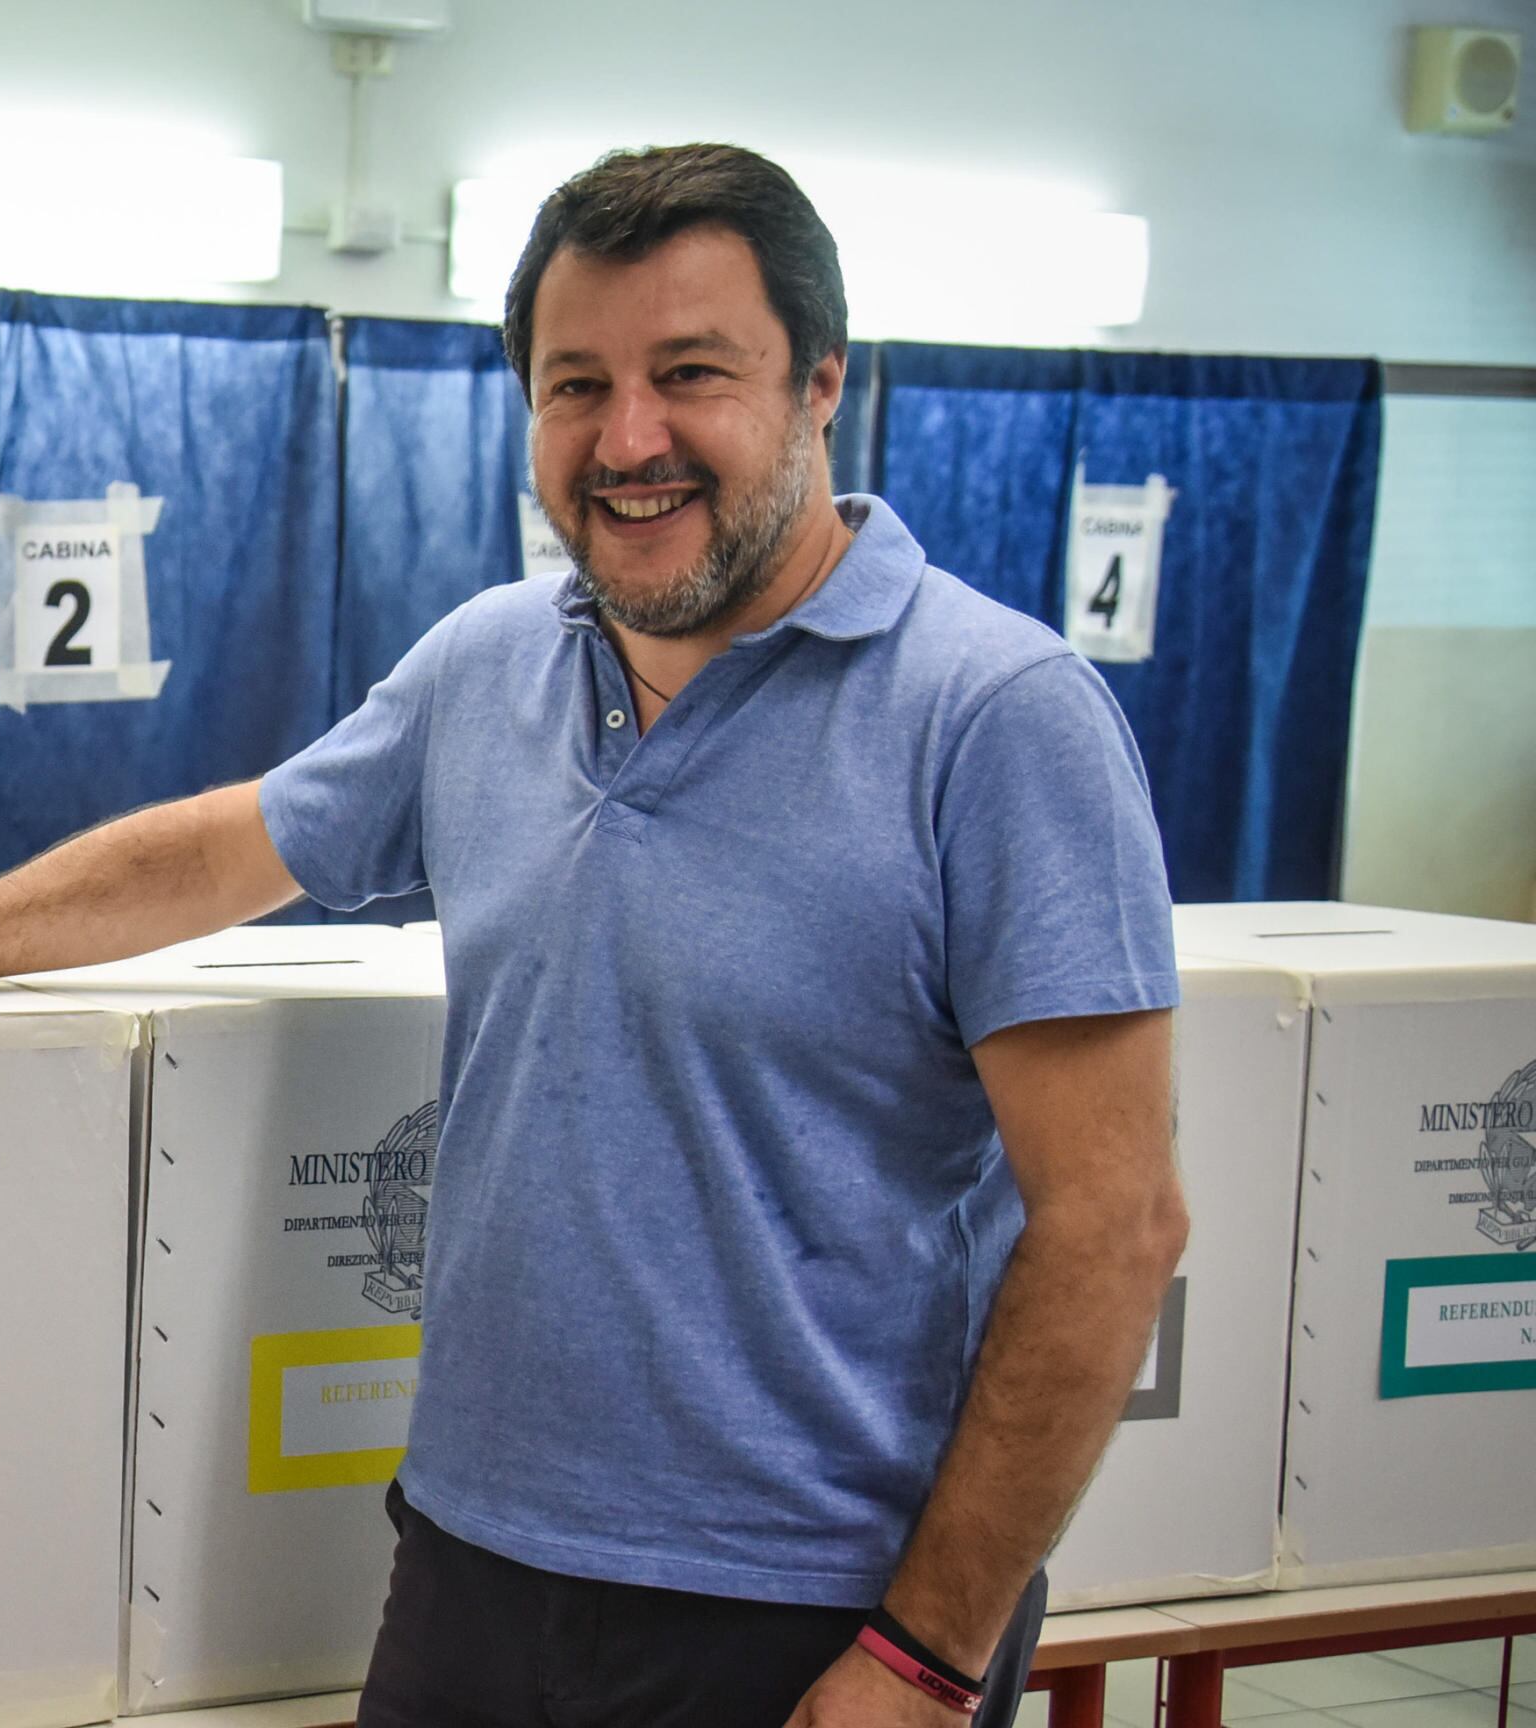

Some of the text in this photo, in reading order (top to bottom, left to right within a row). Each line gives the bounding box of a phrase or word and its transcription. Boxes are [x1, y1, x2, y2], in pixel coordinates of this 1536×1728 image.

[22, 540, 112, 561] CABINA
[1089, 553, 1121, 629] 4
[44, 578, 92, 666] 2
[1419, 1101, 1534, 1132] MINISTERO
[288, 1150, 426, 1186] MINISTERO
[1414, 1159, 1489, 1172] DIPARTIMENTO
[284, 1215, 375, 1231] DIPARTIMENTO
[379, 1213, 400, 1227] PER
[328, 1253, 385, 1267] DIREZIONE
[1440, 1300, 1536, 1321] REFERENDU
[1521, 1328, 1536, 1344] N.
